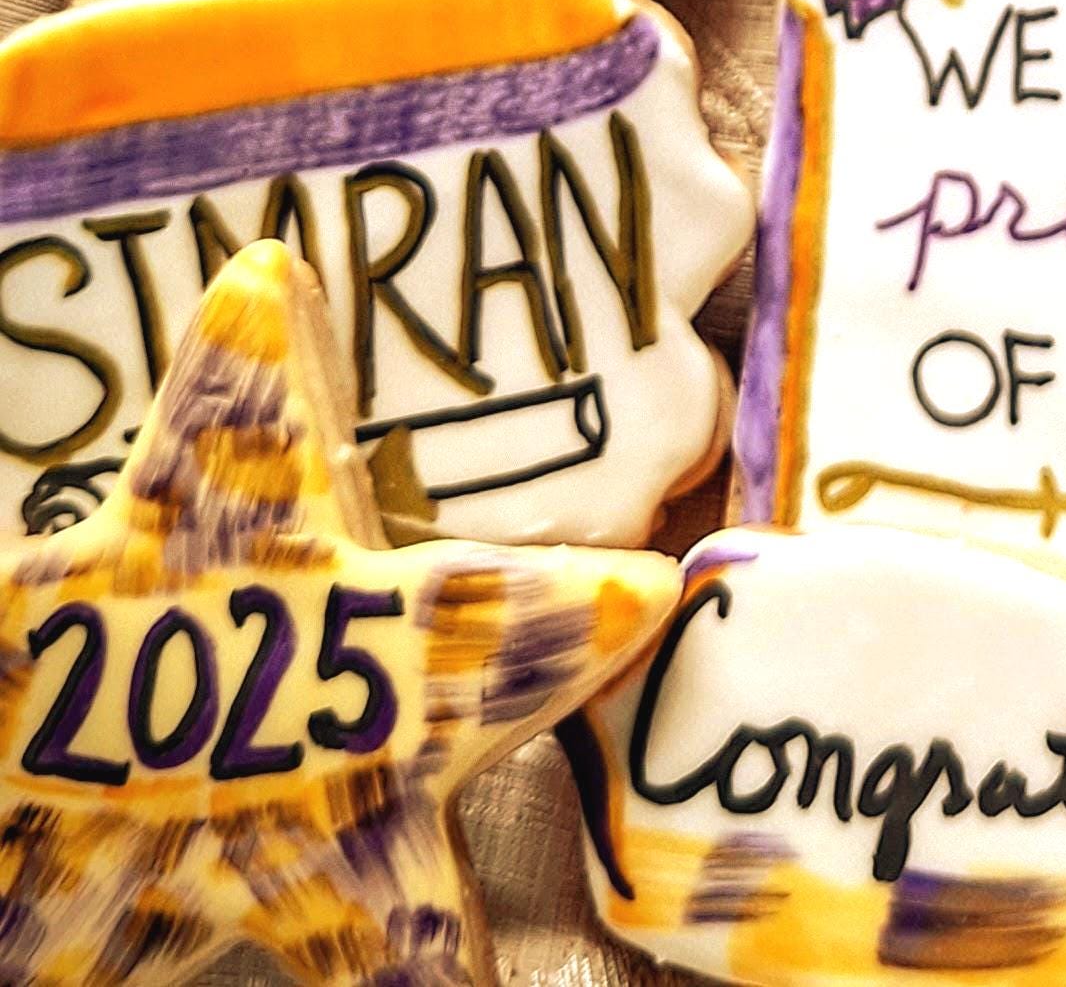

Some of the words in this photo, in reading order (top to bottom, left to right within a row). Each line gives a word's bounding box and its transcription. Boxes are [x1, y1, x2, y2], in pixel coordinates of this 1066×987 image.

[896, 4, 1062, 110] WE
[911, 328, 1055, 427] OF
[20, 582, 404, 787] 2025
